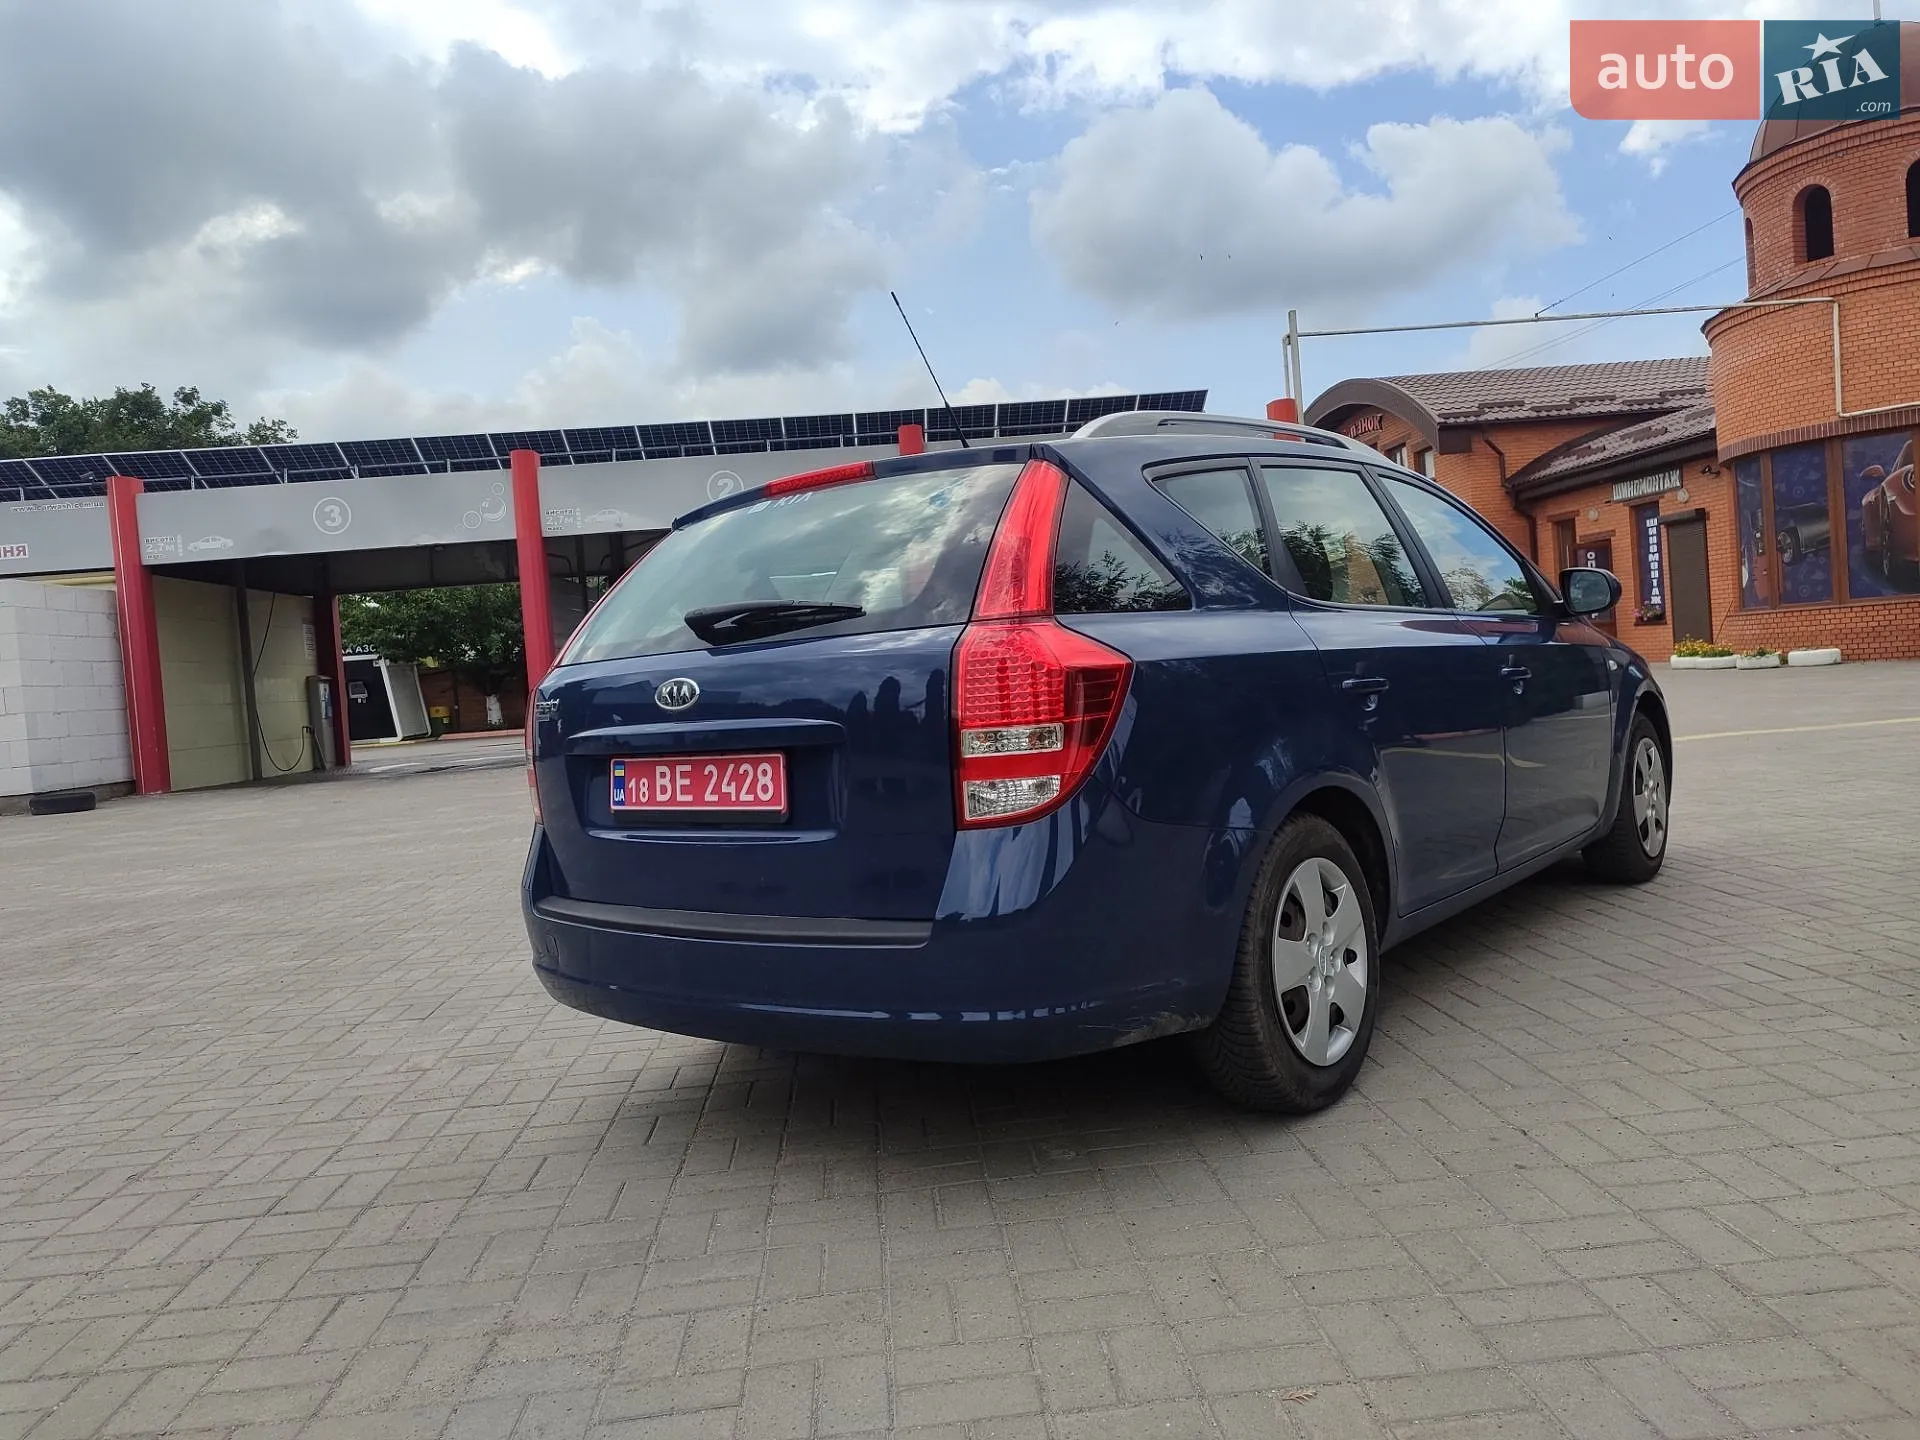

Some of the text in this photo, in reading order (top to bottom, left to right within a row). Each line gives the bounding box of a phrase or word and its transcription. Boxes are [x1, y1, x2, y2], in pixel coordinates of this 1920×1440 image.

[1612, 469, 1680, 501] ШИНОМОНТАЖ
[323, 504, 342, 527] 3
[0, 545, 27, 558] НЯ
[1646, 517, 1662, 605] ШИНОМОНТАЖ
[355, 644, 376, 654] АЗС
[661, 681, 691, 704] KIA
[613, 762, 774, 804] UA 18 BE 2428
